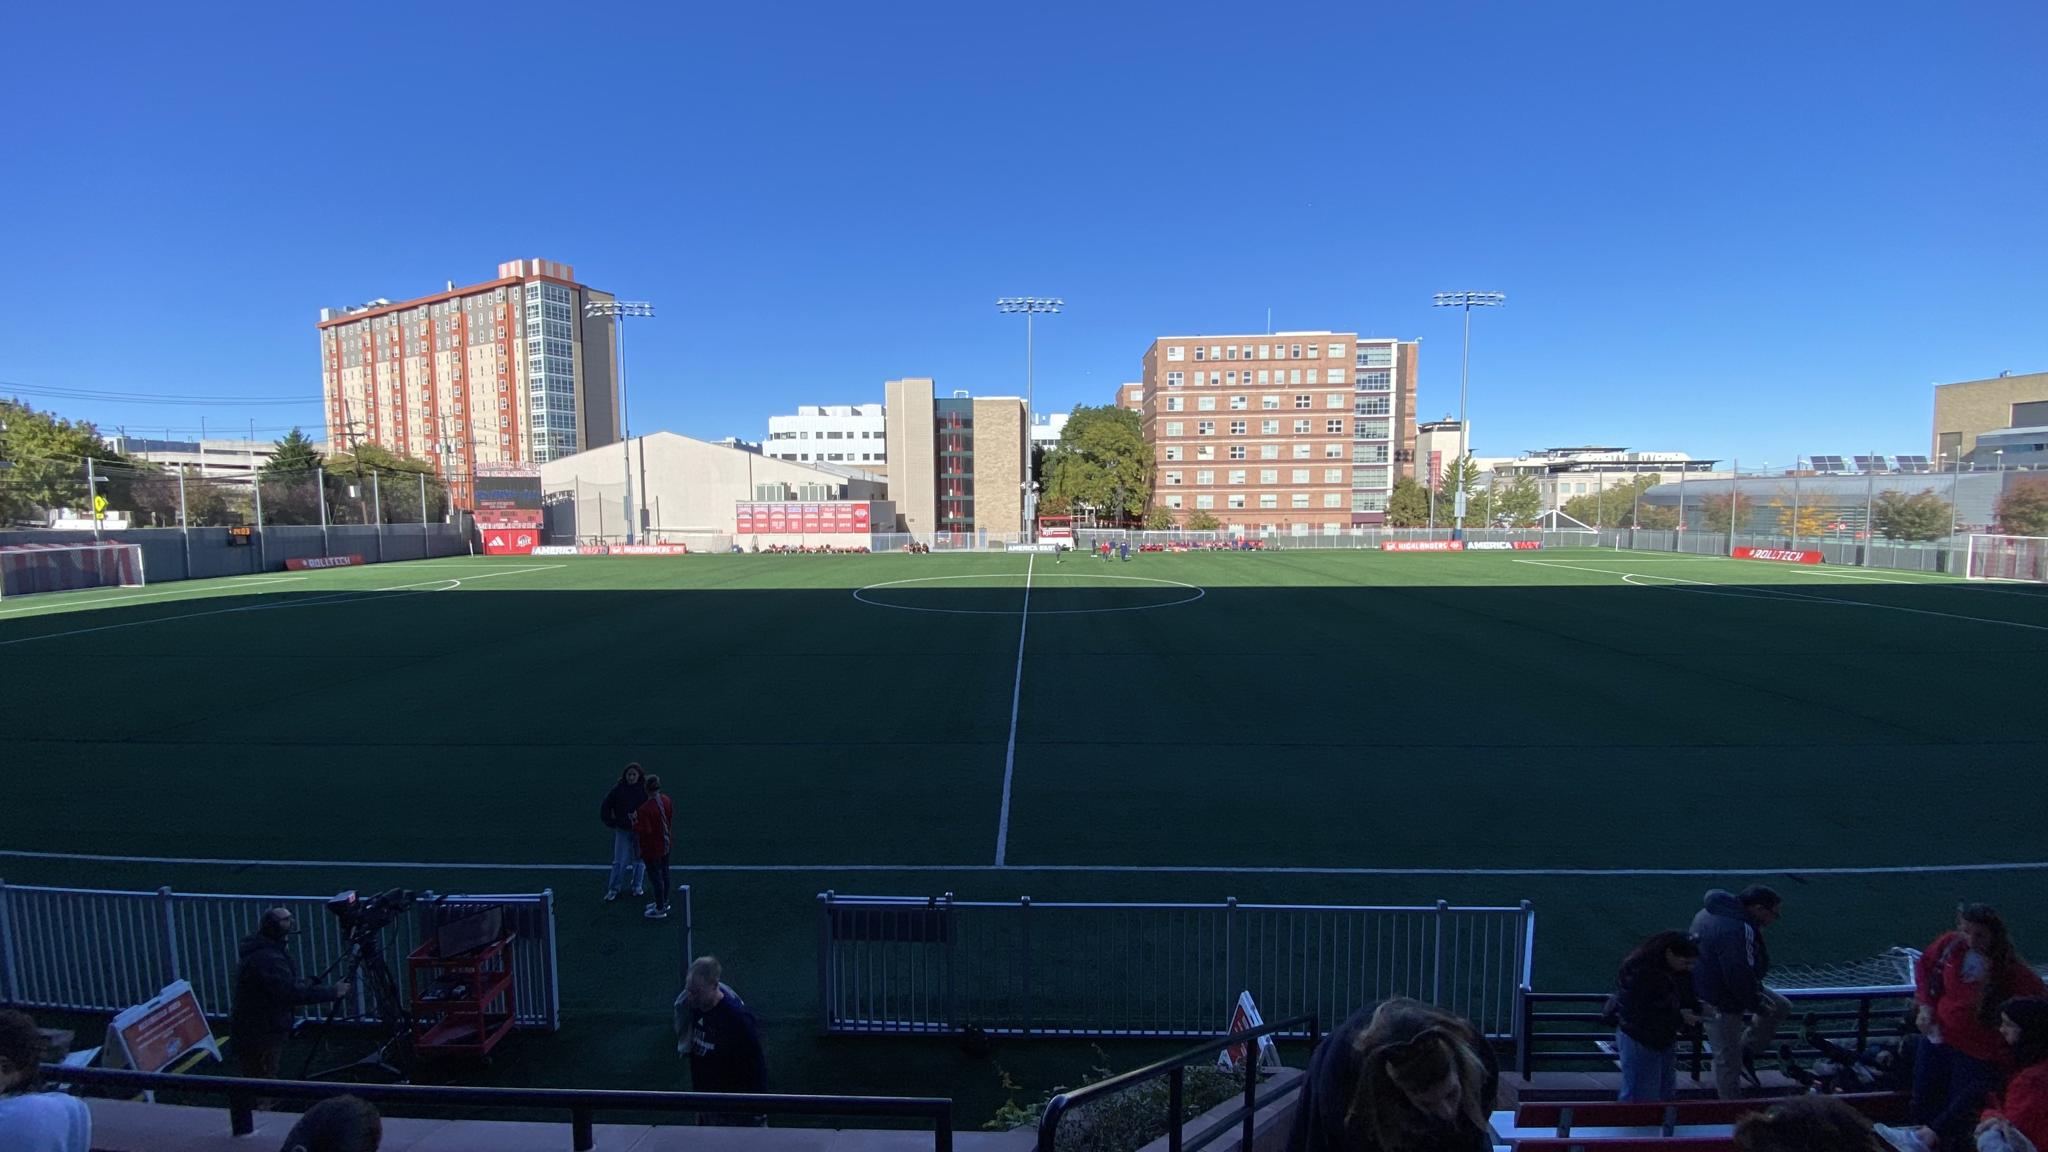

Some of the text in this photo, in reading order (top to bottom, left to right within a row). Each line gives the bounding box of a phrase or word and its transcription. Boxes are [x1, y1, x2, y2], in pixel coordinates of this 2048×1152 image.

[1398, 541, 1447, 550] HIGHLANDERS
[1467, 541, 1540, 550] AMERICA EAST
[533, 546, 577, 555] AMERICA
